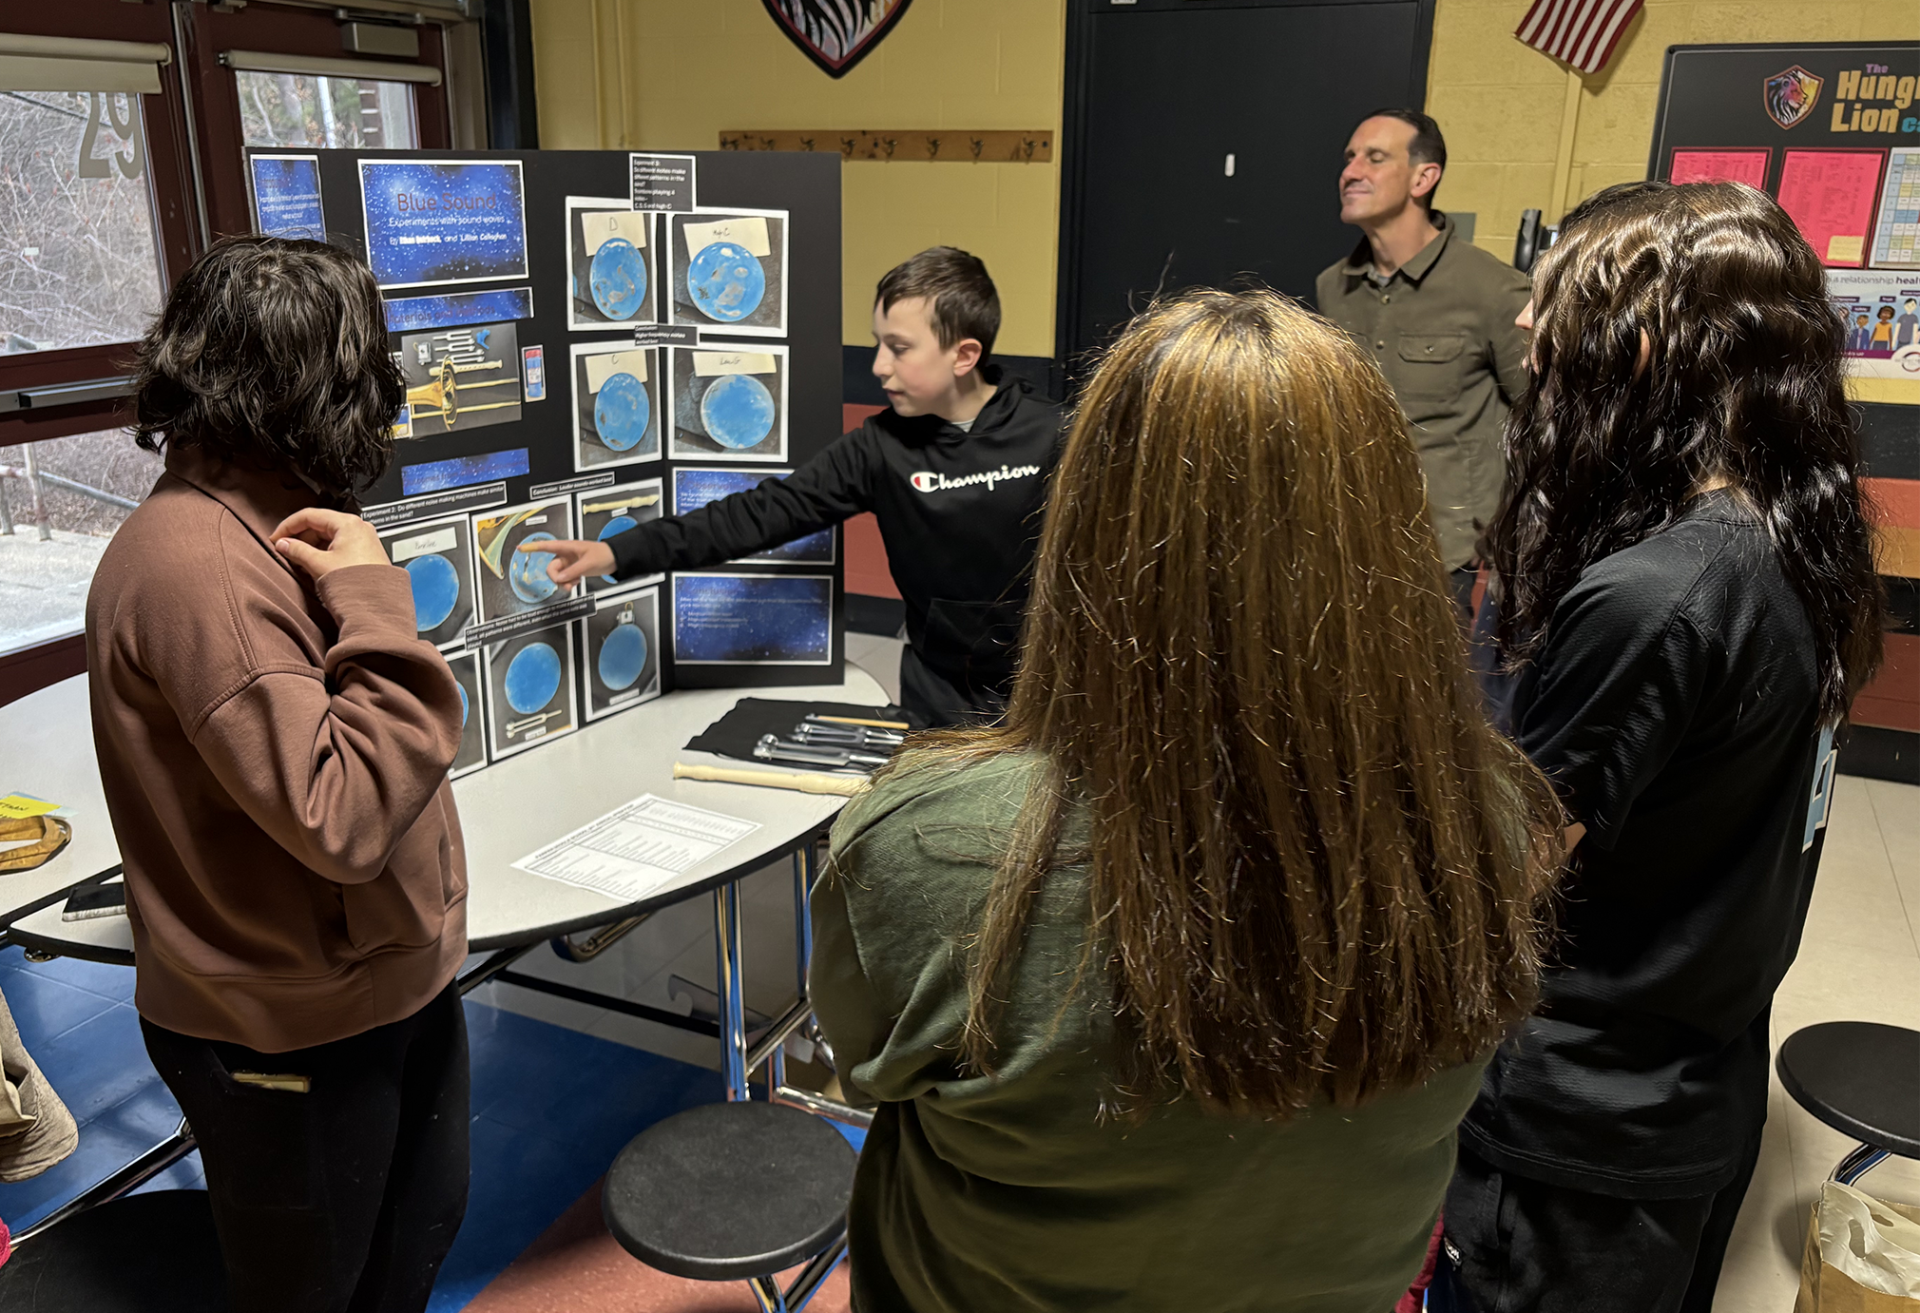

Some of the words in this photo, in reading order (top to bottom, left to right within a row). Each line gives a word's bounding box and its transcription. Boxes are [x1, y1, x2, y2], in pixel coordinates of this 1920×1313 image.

[1866, 64, 1889, 73] The
[1830, 102, 1900, 133] Lion
[79, 91, 143, 178] 29
[397, 193, 437, 212] Blue
[442, 192, 496, 211] Sound
[389, 217, 439, 228] Experiments
[440, 216, 457, 225] with
[458, 216, 482, 225] sound
[482, 216, 505, 224] waves
[609, 216, 618, 231] D
[1840, 275, 1894, 285] relationship
[1896, 276, 1920, 284] heal
[434, 309, 453, 320] and
[910, 464, 1041, 493] Champion
[364, 508, 391, 519] Experiment
[405, 500, 425, 510] different
[455, 491, 477, 500] machines
[477, 488, 489, 496] make
[399, 510, 414, 519] sand?
